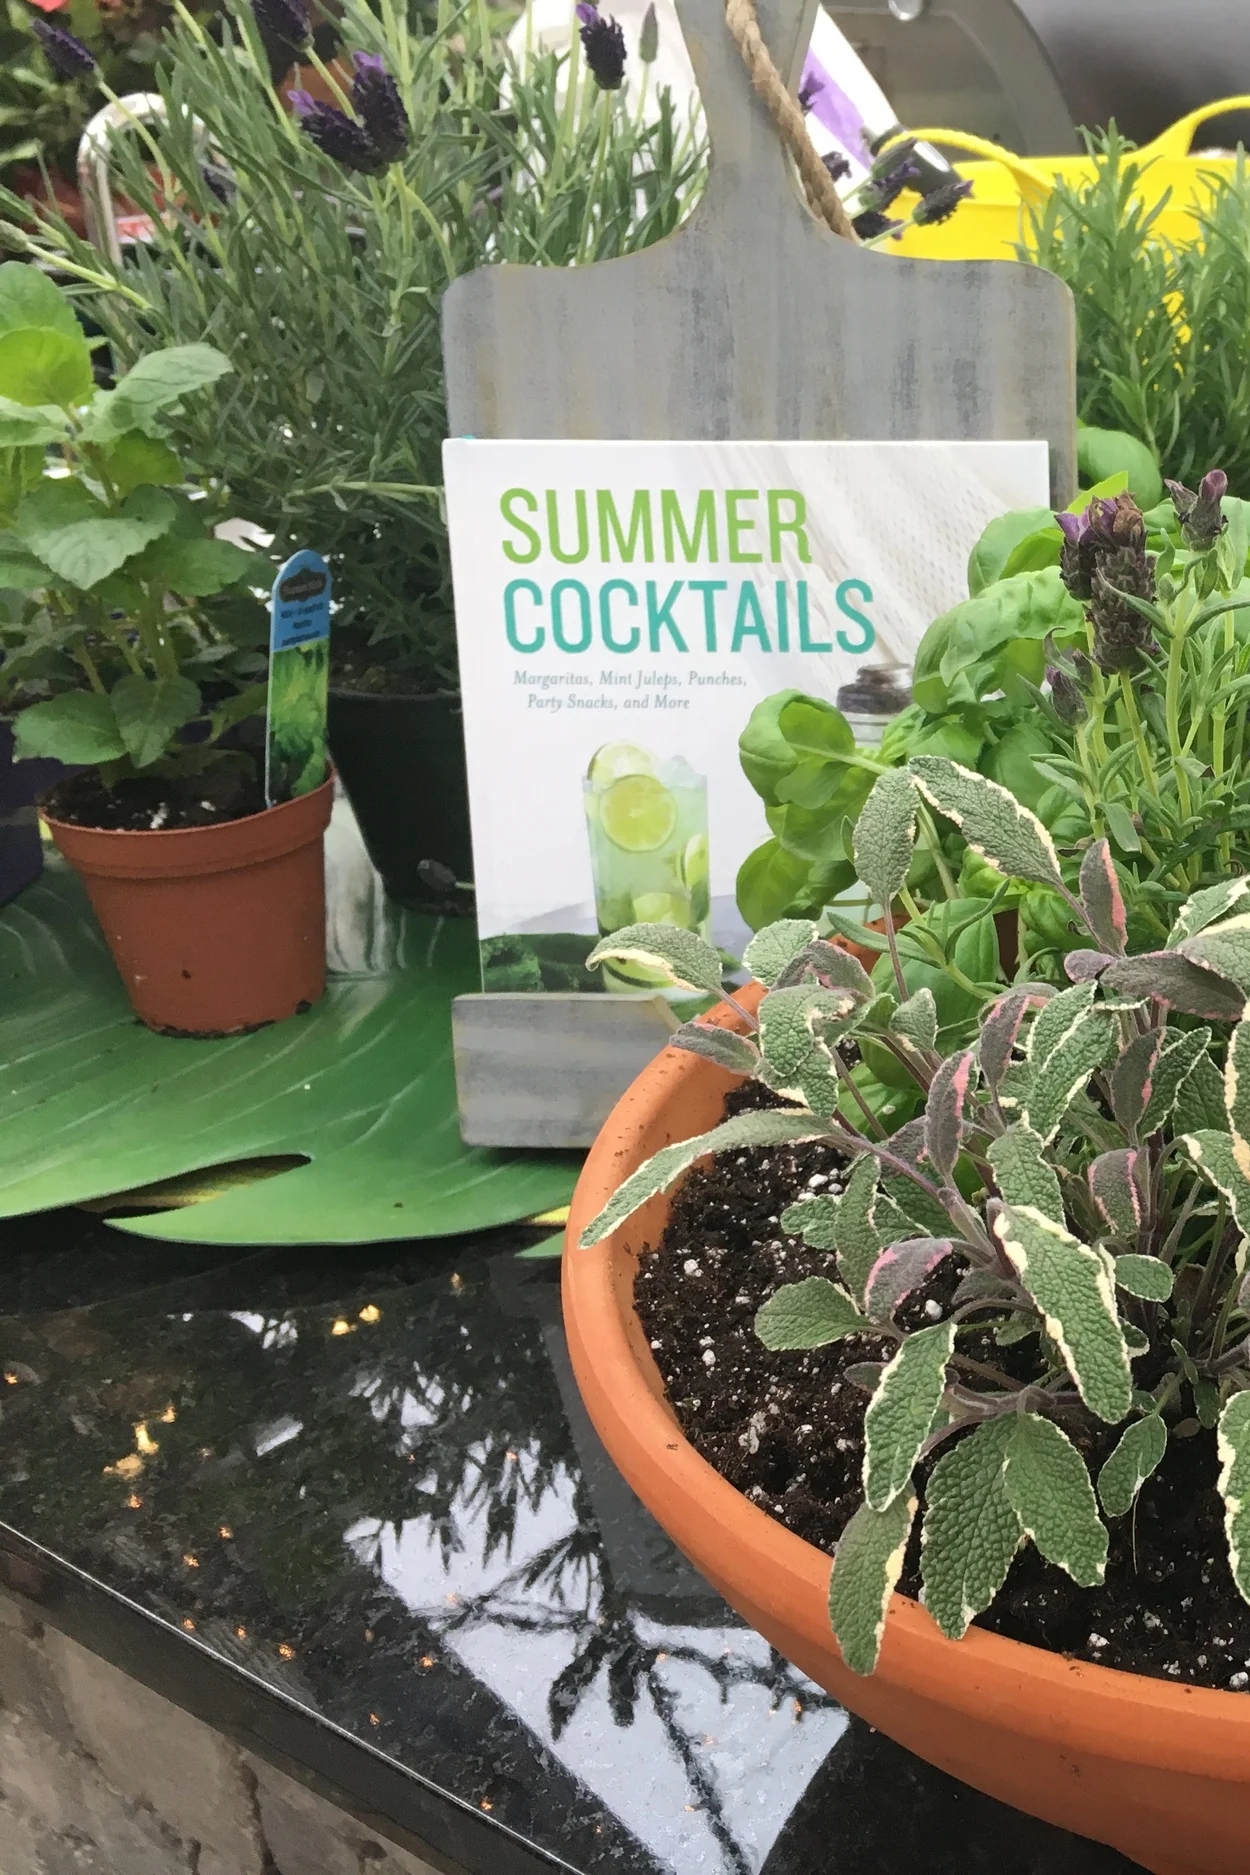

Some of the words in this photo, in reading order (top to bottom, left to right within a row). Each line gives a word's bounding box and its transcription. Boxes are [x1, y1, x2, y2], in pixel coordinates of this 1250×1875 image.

[500, 487, 813, 565] SUMMER
[504, 578, 876, 655] COCKTAILS
[512, 670, 594, 690] Margaritas,
[599, 670, 633, 686] Mint
[635, 670, 682, 690] Juleps,
[688, 671, 747, 687] Punches,
[527, 693, 563, 713] Party
[567, 694, 618, 710] Snacks,
[623, 694, 650, 709] and
[653, 694, 690, 709] More
